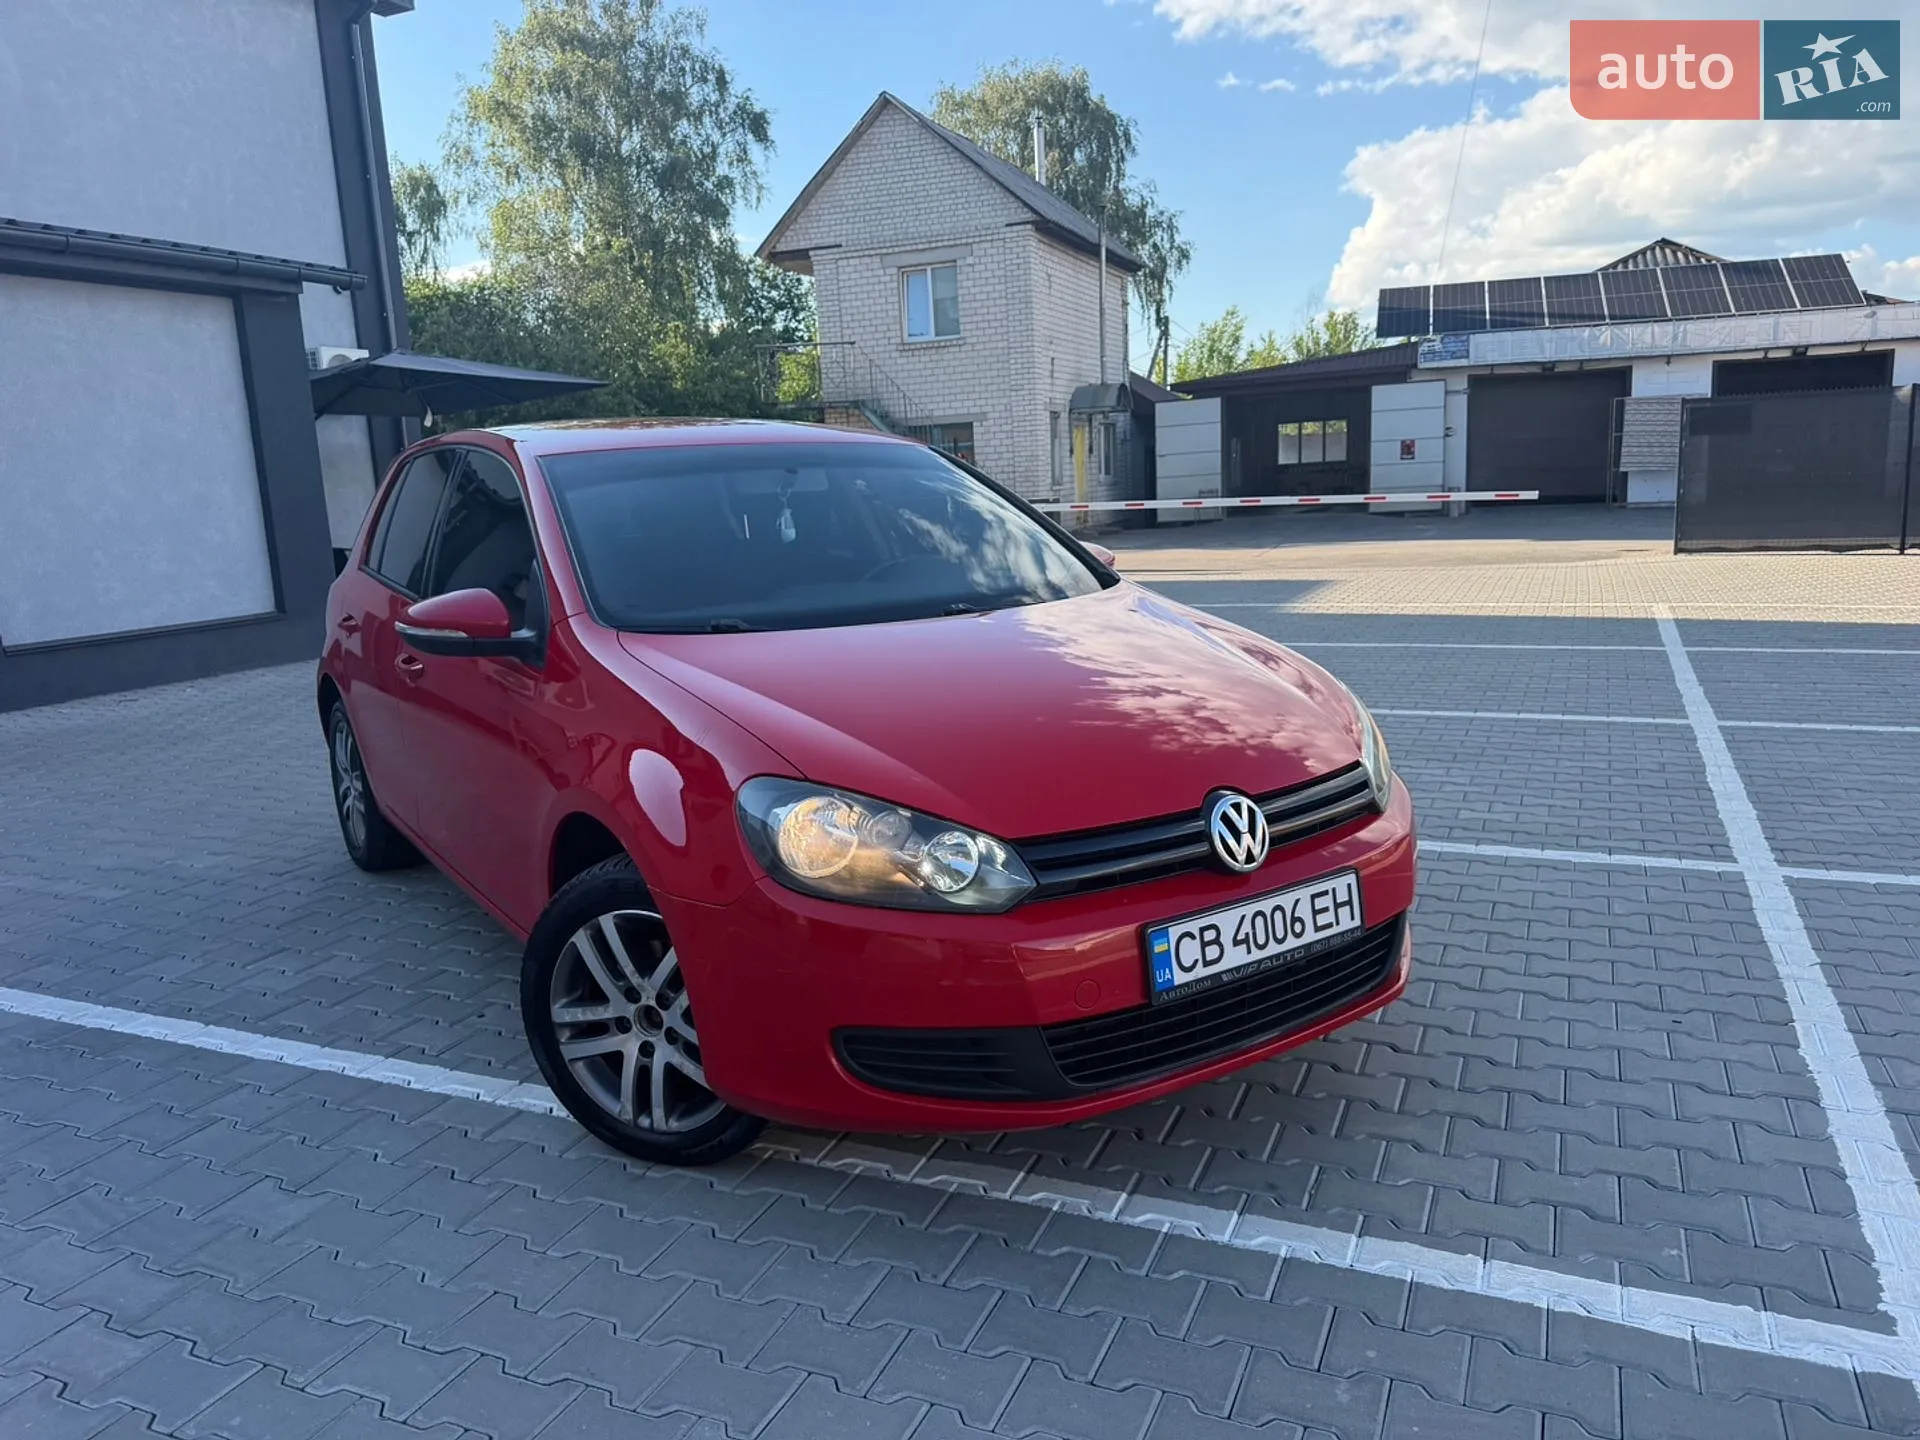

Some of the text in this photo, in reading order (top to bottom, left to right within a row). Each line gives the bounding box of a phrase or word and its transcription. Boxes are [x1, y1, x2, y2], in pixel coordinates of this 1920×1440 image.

[1174, 883, 1355, 973] CB 4006 EH
[1156, 967, 1172, 983] UA
